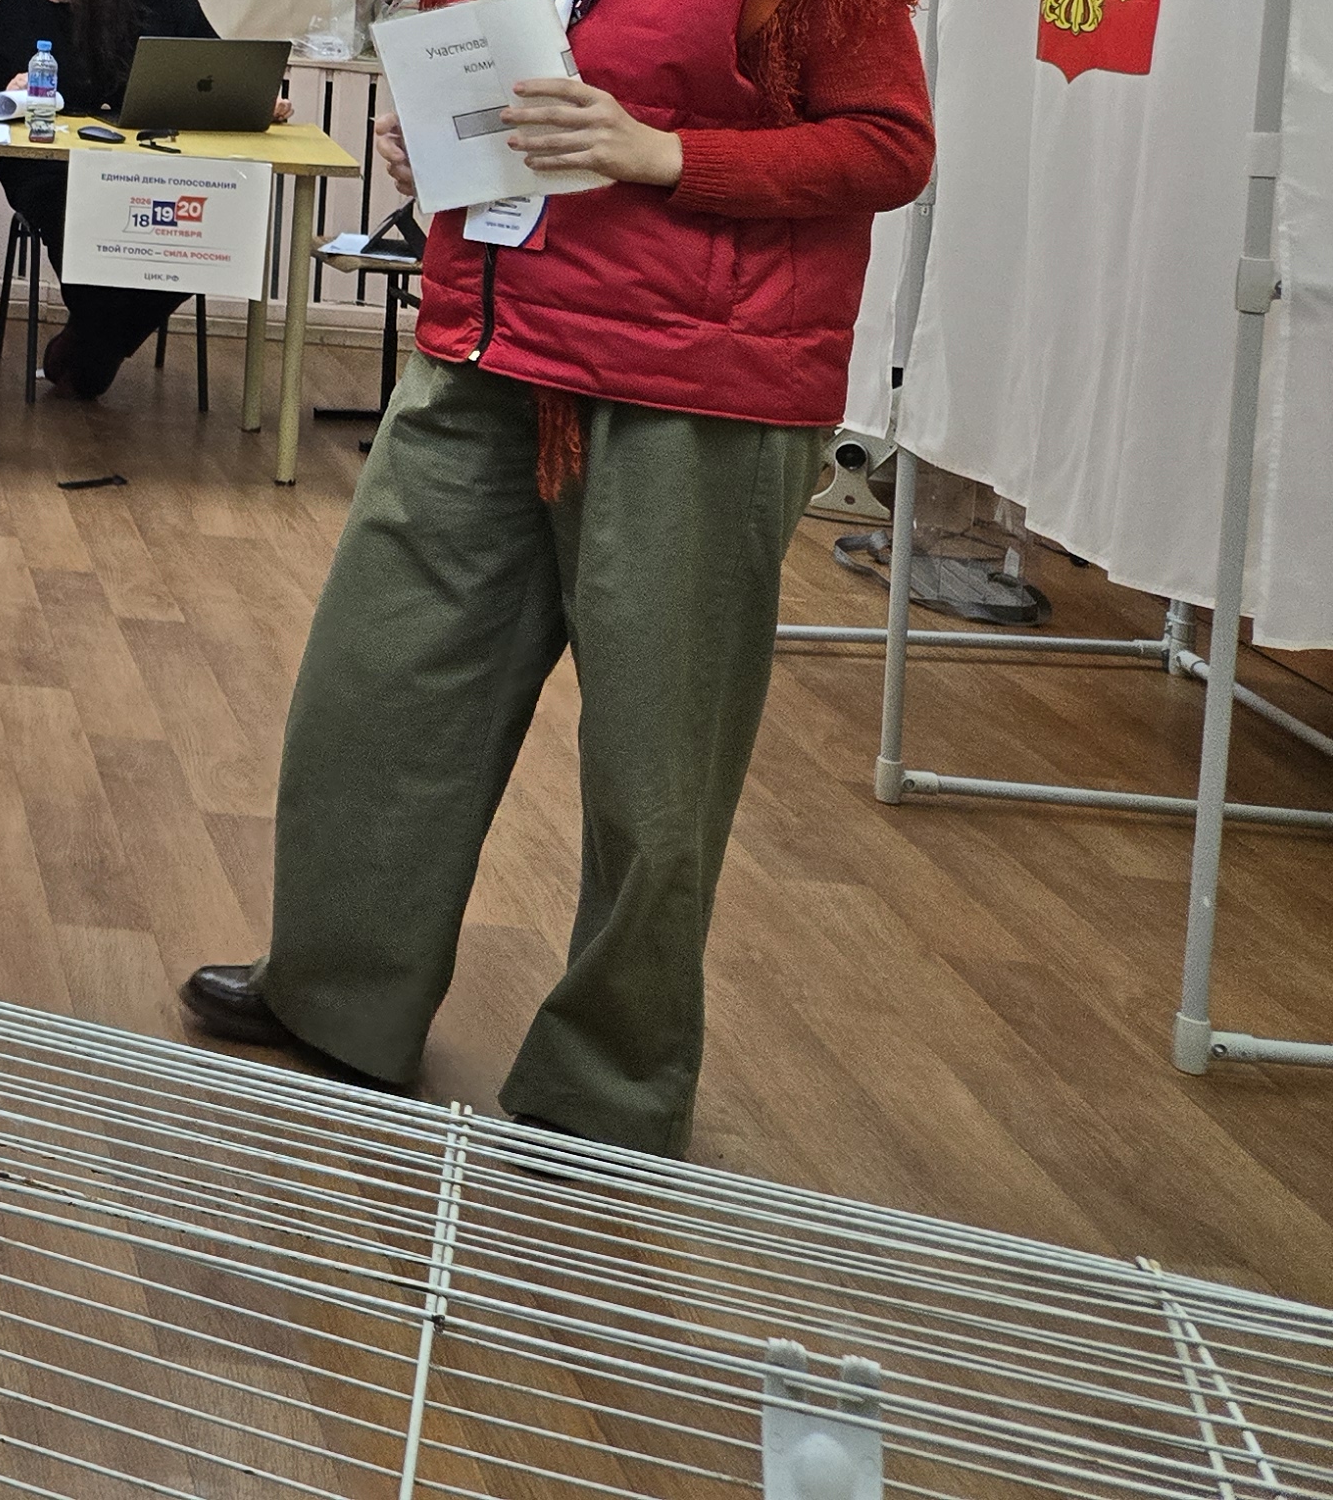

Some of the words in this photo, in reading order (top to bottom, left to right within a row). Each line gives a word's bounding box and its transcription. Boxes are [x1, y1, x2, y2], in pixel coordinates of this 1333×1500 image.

[101, 173, 140, 183] ЕДИНЫЙ
[141, 176, 166, 184] ДЕНЬ
[168, 178, 237, 190] ГОЛОСОВАНИЯ
[132, 213, 150, 228] 18
[154, 206, 173, 222] 19
[177, 201, 201, 218] 20
[155, 228, 203, 238] СЕНТЯБРЯ
[97, 244, 121, 253] ТВОЙ
[123, 246, 153, 256] ГОЛОС
[163, 249, 188, 258] СИЛА
[190, 251, 231, 261] РОССИИ!
[144, 272, 179, 282] ЦИК.РФ
